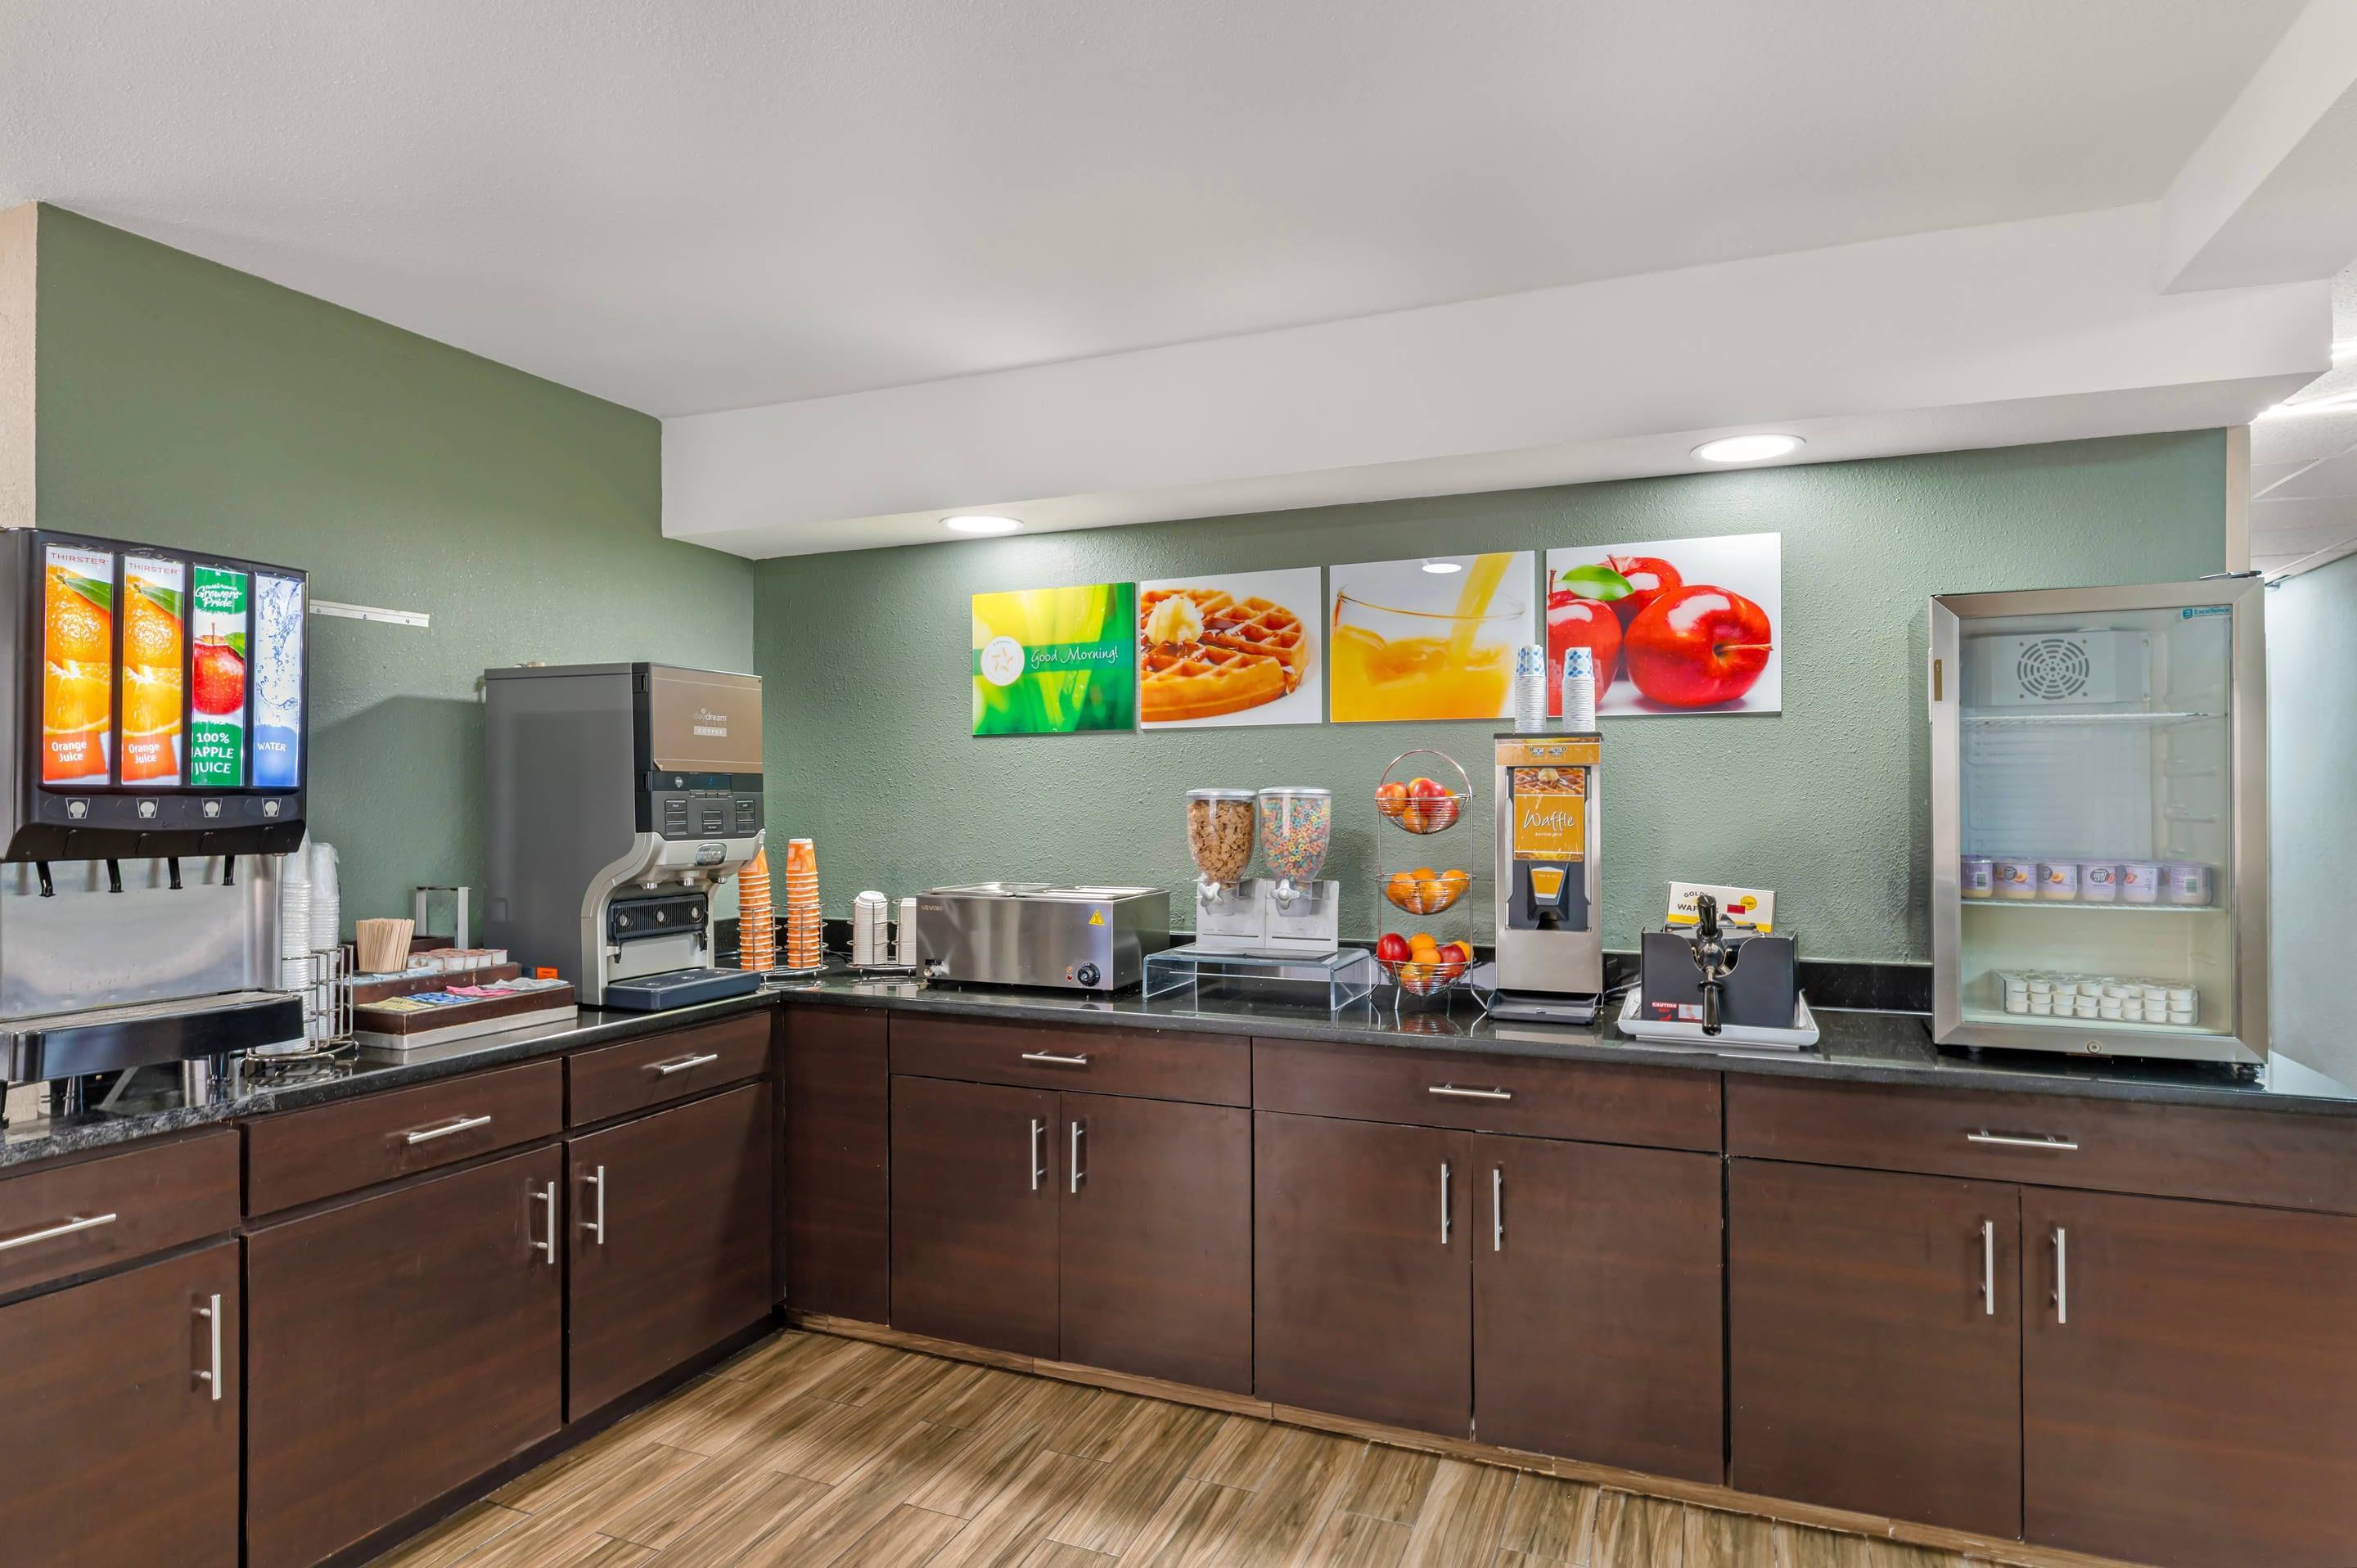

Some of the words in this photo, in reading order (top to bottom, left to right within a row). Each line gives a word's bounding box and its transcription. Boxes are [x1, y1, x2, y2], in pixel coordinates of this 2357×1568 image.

[51, 552, 106, 565] THIRSTER
[128, 562, 178, 574] THIRSTER
[202, 597, 232, 608] Pride
[1031, 649, 1057, 669] Good
[1061, 646, 1119, 664] Morning!
[693, 710, 727, 721] daydream
[196, 732, 230, 744] 100%
[52, 741, 87, 752] Orange
[128, 742, 160, 754] Orange
[193, 746, 235, 759] APPLE
[257, 741, 286, 752] WATER
[59, 752, 83, 762] Juice
[134, 754, 156, 764] Juice
[195, 761, 232, 776] JUICE
[1524, 809, 1575, 832] Waffle
